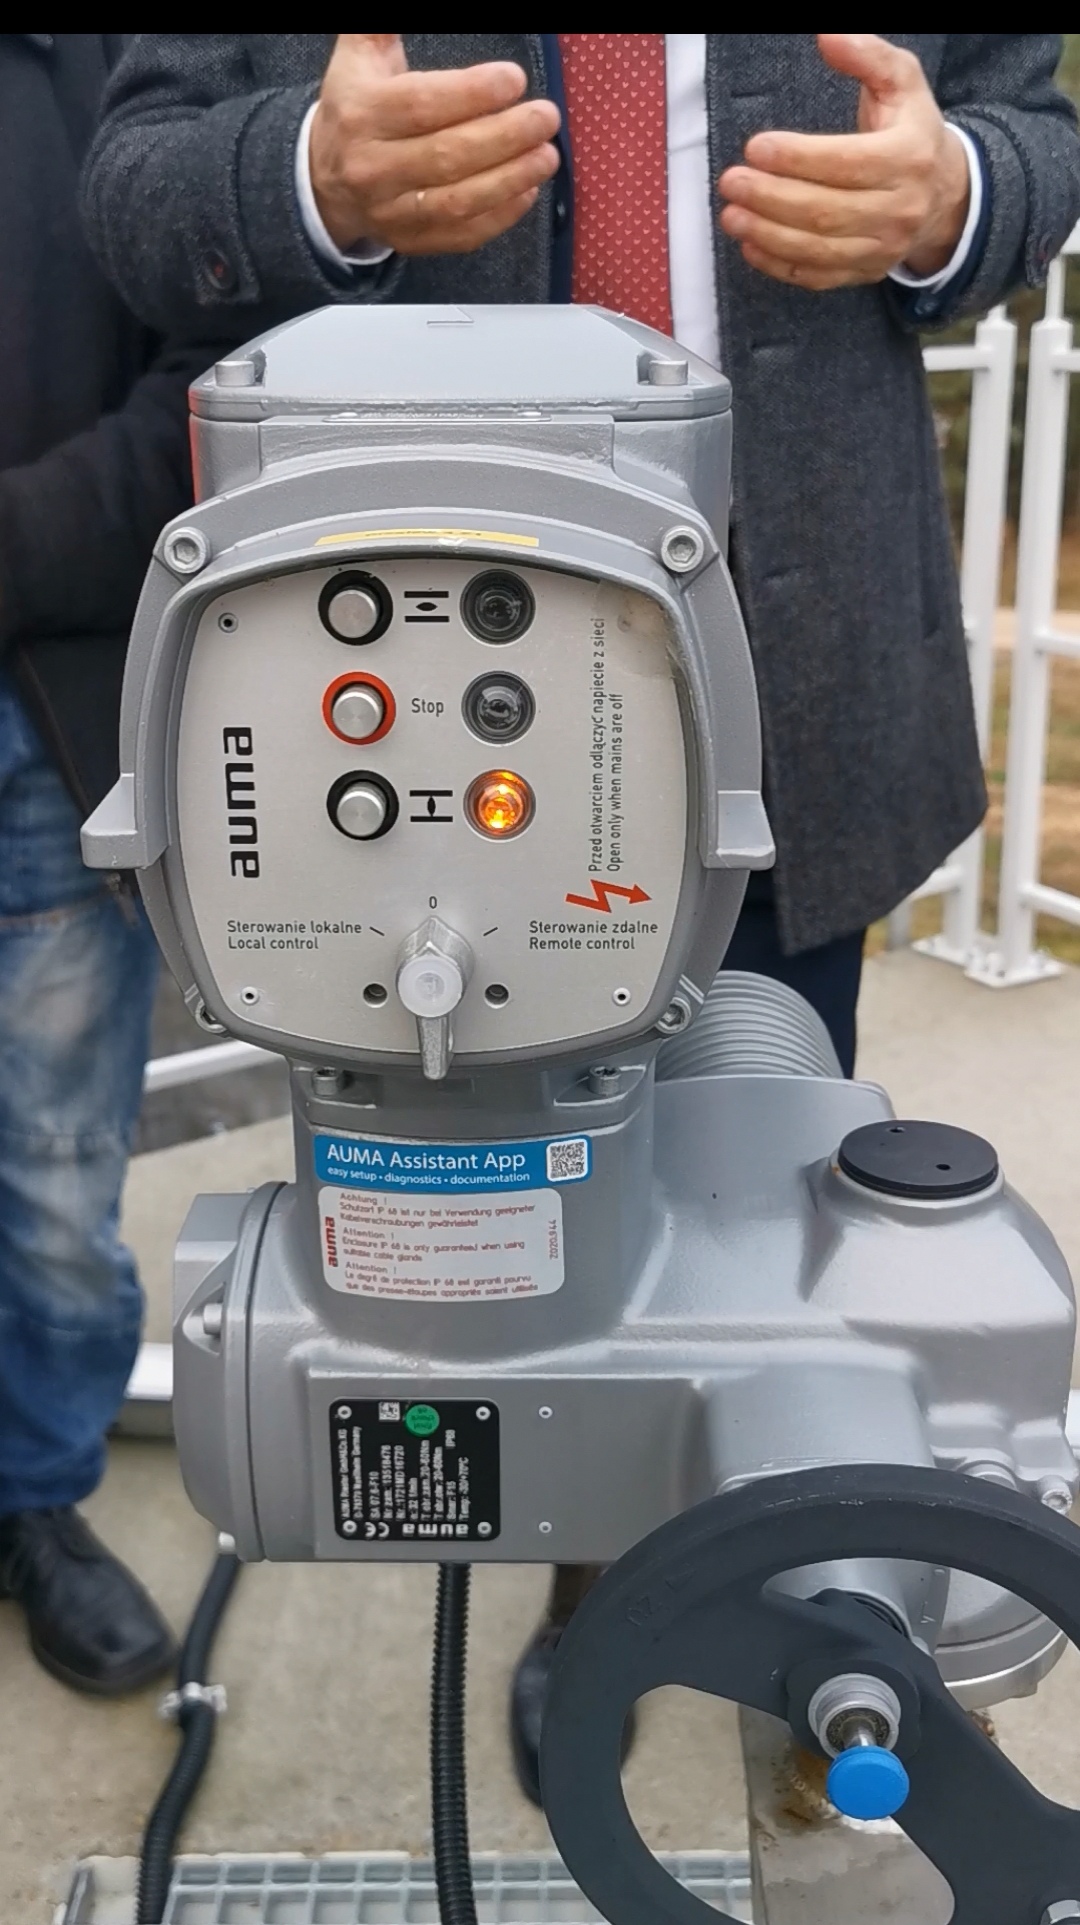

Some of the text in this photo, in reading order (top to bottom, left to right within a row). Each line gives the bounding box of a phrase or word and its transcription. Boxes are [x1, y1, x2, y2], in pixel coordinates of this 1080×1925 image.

[590, 617, 606, 648] sieci
[411, 697, 444, 717] Stop
[607, 693, 624, 872] Open only when mains are off
[223, 727, 260, 878] auma
[589, 773, 603, 836] otwarciem
[588, 838, 603, 872] Przed
[227, 920, 362, 934] Sterowanie lokalne
[529, 920, 659, 934] Sterowanie zdalne
[228, 936, 319, 949] Local control
[529, 937, 635, 950] Remote control
[327, 1143, 526, 1172] AUMA Assistant App
[327, 1167, 530, 1186] easy setup diagnostics documentation
[340, 1193, 378, 1205] Achtung
[413, 1209, 425, 1217] nur
[325, 1216, 338, 1267] auma
[343, 1227, 385, 1239] Attention
[345, 1261, 388, 1274] Attention
